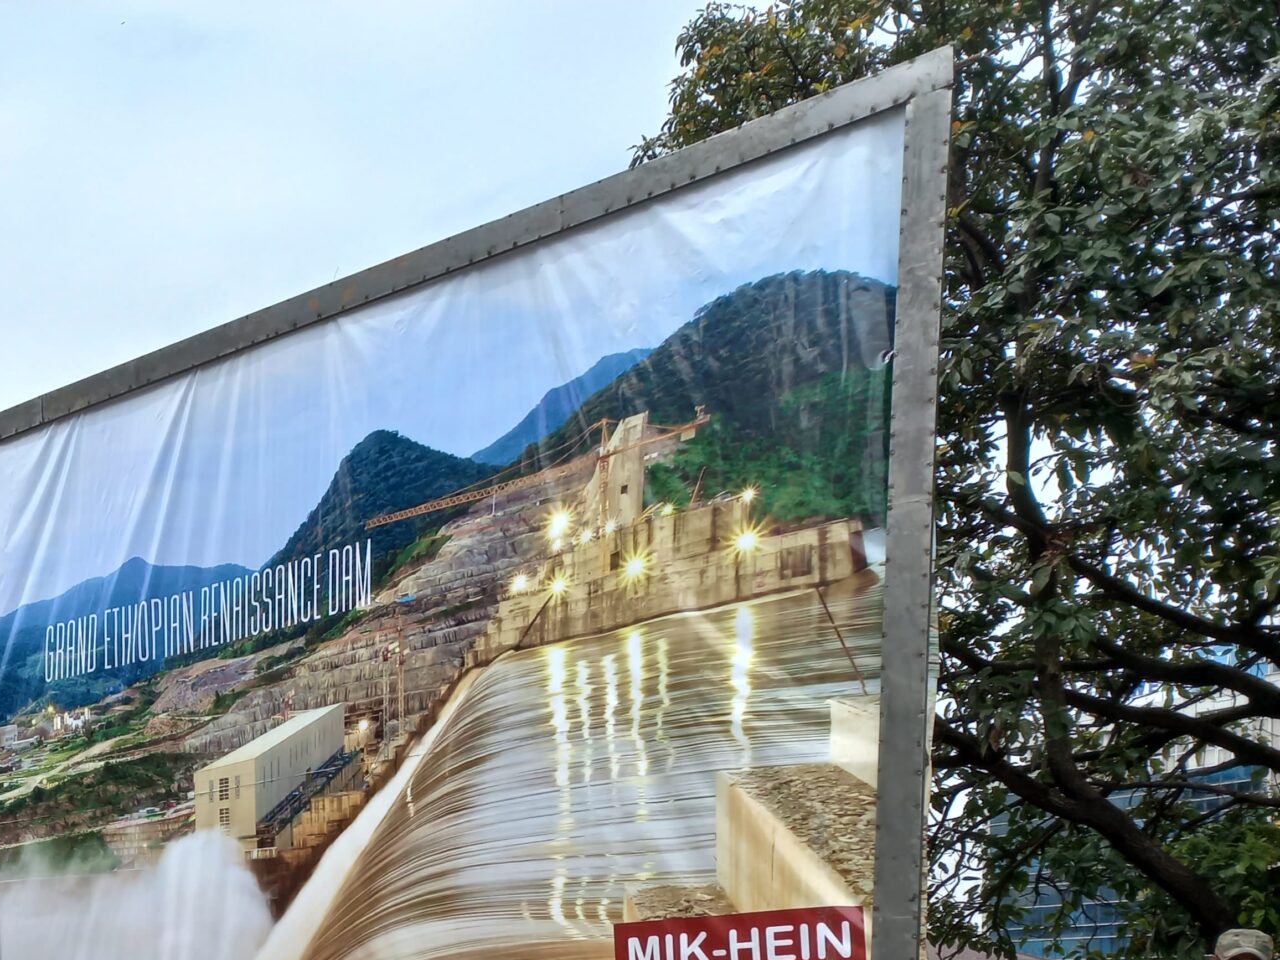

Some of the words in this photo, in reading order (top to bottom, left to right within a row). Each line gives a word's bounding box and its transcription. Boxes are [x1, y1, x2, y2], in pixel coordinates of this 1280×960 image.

[44, 613, 97, 682] GRAND
[104, 590, 194, 669] ETHIOPIAN
[200, 553, 322, 648] RENAISSANCE
[328, 538, 372, 615] DAM
